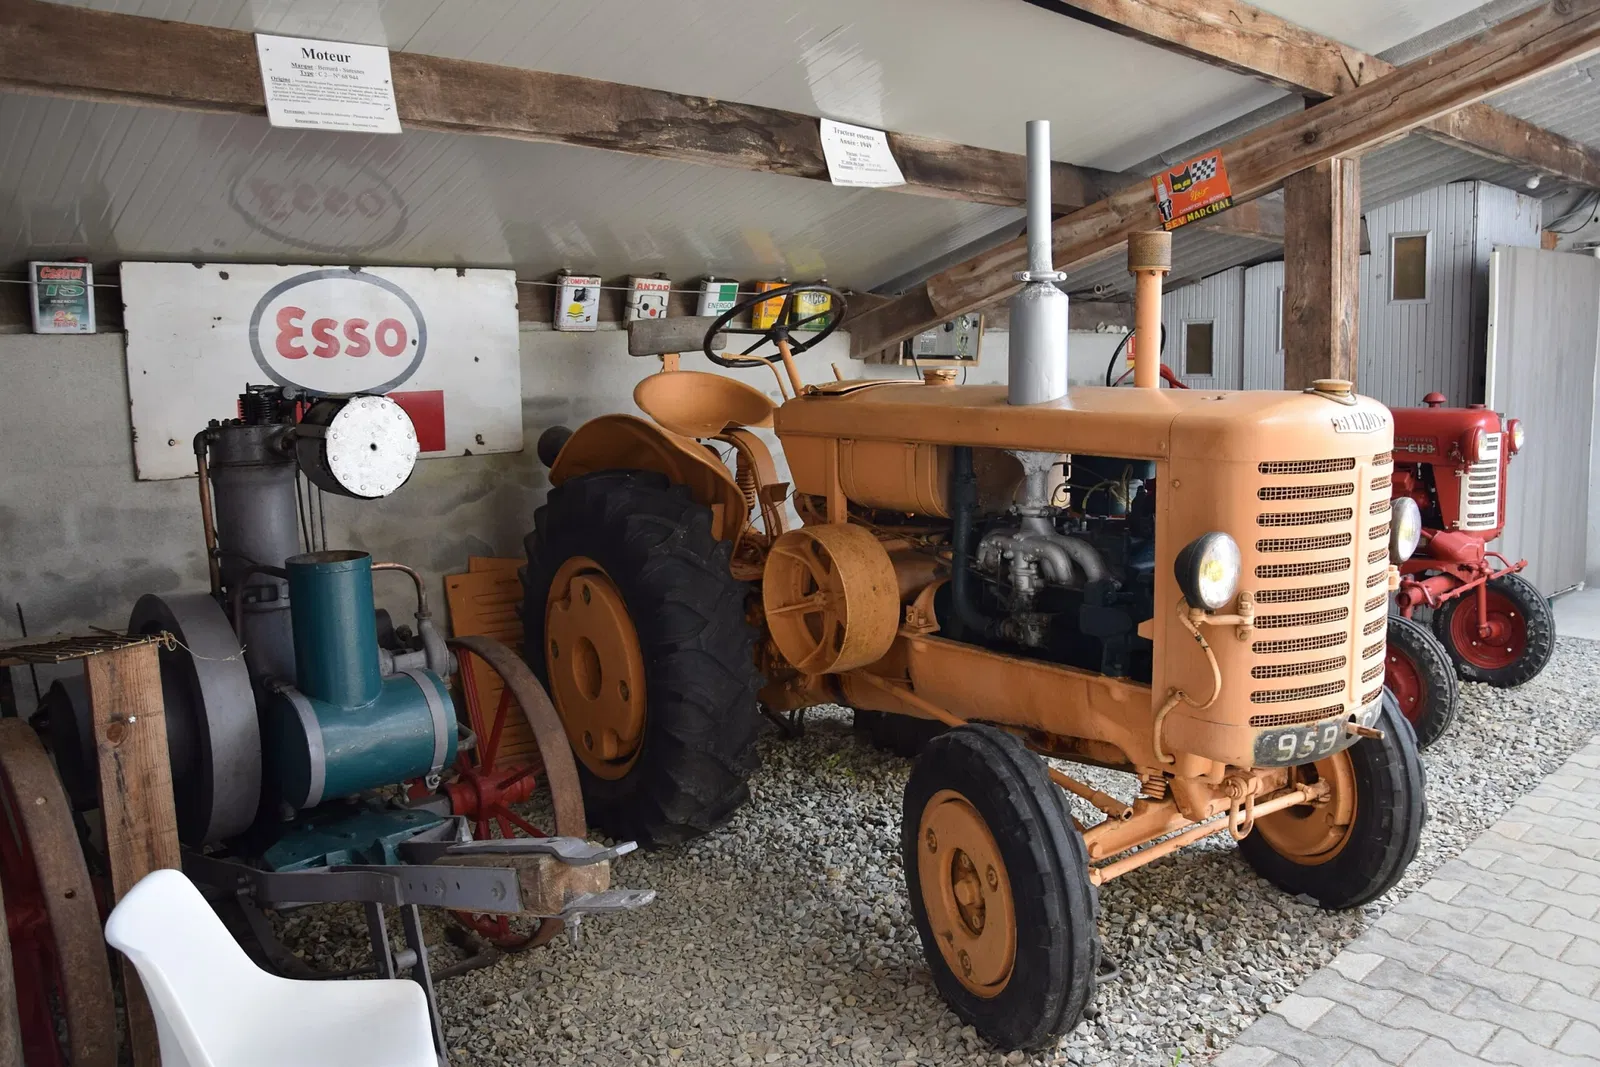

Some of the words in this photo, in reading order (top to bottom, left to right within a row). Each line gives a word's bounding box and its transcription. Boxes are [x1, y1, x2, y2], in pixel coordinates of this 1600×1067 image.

[301, 47, 351, 63] Moteur
[291, 62, 314, 71] Marque
[270, 75, 290, 83] Origine
[300, 70, 314, 78] Type
[1187, 199, 1231, 222] MARCHAL
[40, 266, 83, 280] Castrol
[637, 282, 670, 291] ANTAR
[802, 291, 827, 305] YACCO
[1408, 443, 1433, 453] CUB
